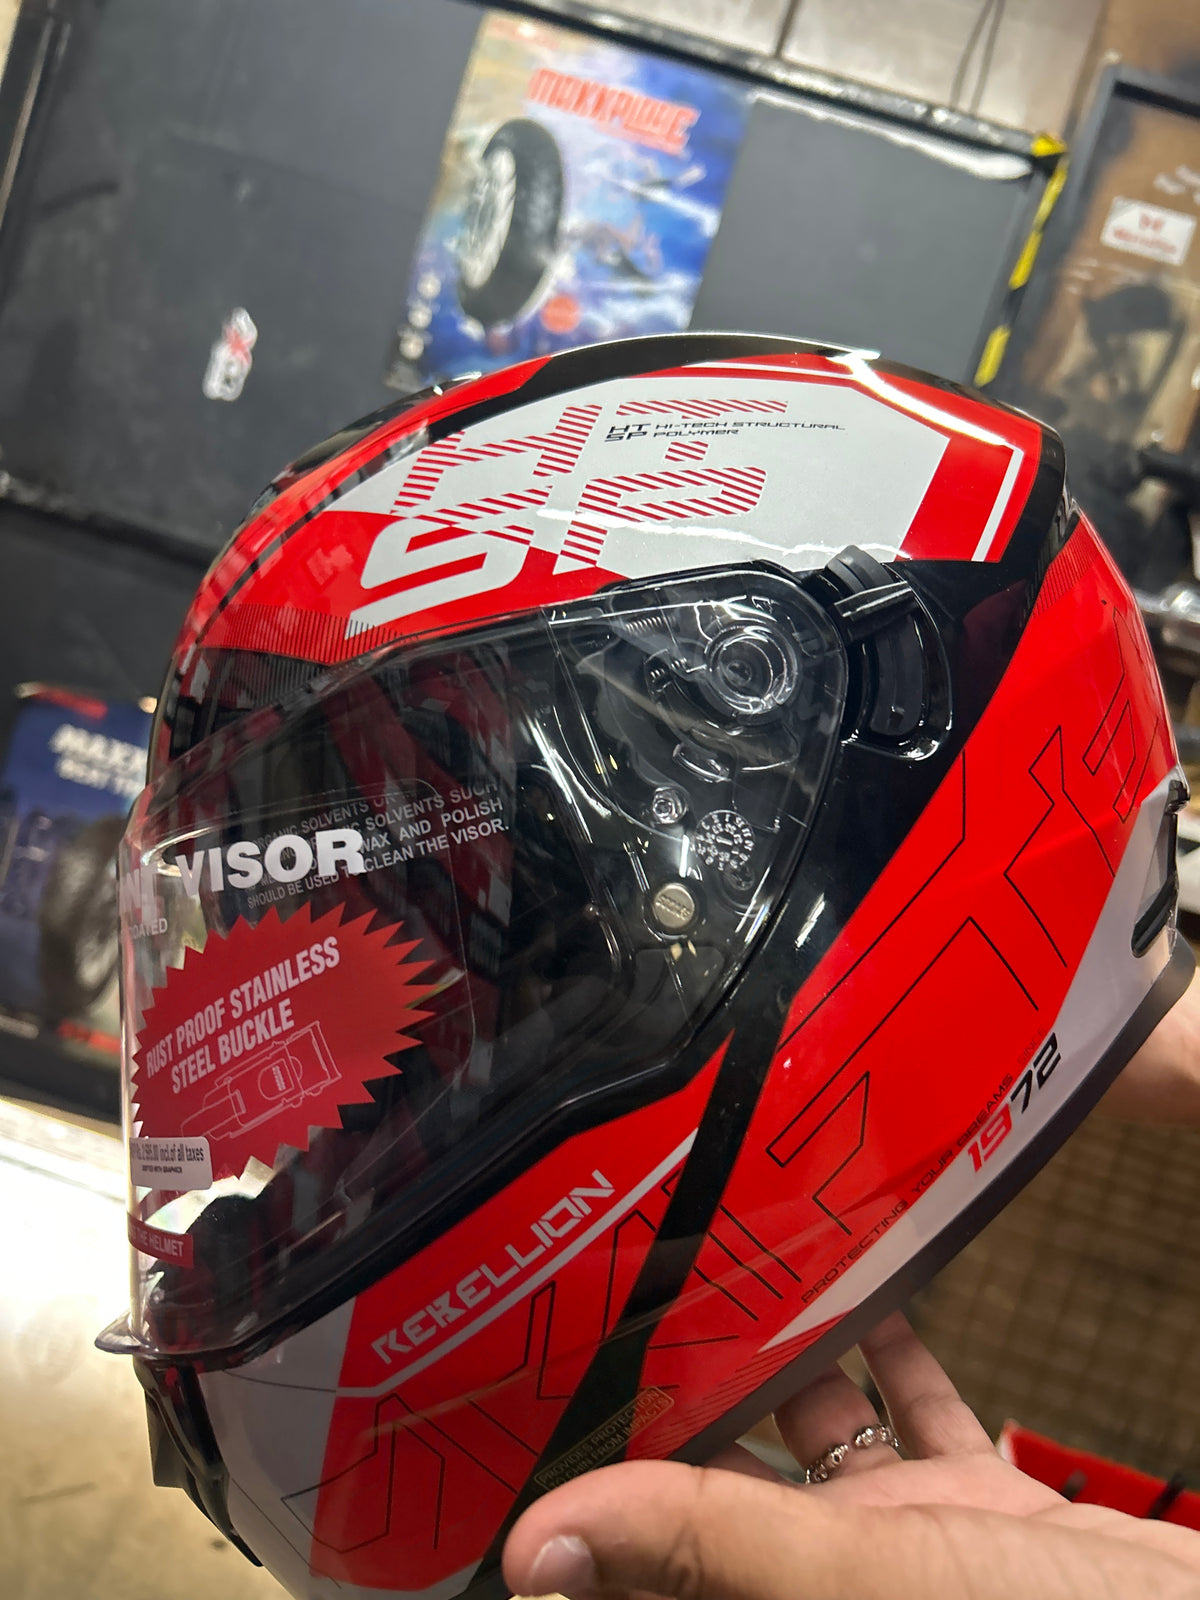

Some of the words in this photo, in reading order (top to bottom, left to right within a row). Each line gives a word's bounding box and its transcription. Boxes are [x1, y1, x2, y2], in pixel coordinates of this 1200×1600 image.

[604, 431, 648, 443] SP
[653, 429, 740, 438] POLYMER
[608, 423, 651, 434] HT
[655, 421, 728, 430] HI-TECH
[732, 421, 846, 431] STRUCTURAL
[300, 801, 369, 834] SOLVENTS
[365, 795, 445, 831] SOLVENTS
[449, 779, 498, 804] SUCH
[399, 819, 432, 841] AND
[441, 797, 503, 828] POLISH
[174, 828, 367, 897] VISOR
[247, 886, 286, 909] SHOULD
[287, 882, 304, 896] BE
[364, 845, 415, 872] CLEAN
[416, 834, 450, 856] THE
[451, 818, 510, 845] VISOR.
[146, 1037, 174, 1078] RUST
[176, 999, 228, 1054] PROOF
[229, 936, 341, 1019] STAINLESS
[170, 1058, 217, 1094] STEEL
[219, 999, 295, 1065] BUCKLE
[967, 1032, 1061, 1173] 1972
[801, 1199, 908, 1304] PROTECTING
[911, 1147, 954, 1194] YOUR
[956, 1073, 1014, 1147] DREAMS
[149, 1233, 184, 1257] HELMET
[540, 1442, 593, 1483] PROVIDES
[592, 1390, 660, 1444] PROTECTION
[591, 1434, 626, 1460] FROM
[623, 1397, 669, 1438] IMPACTS
